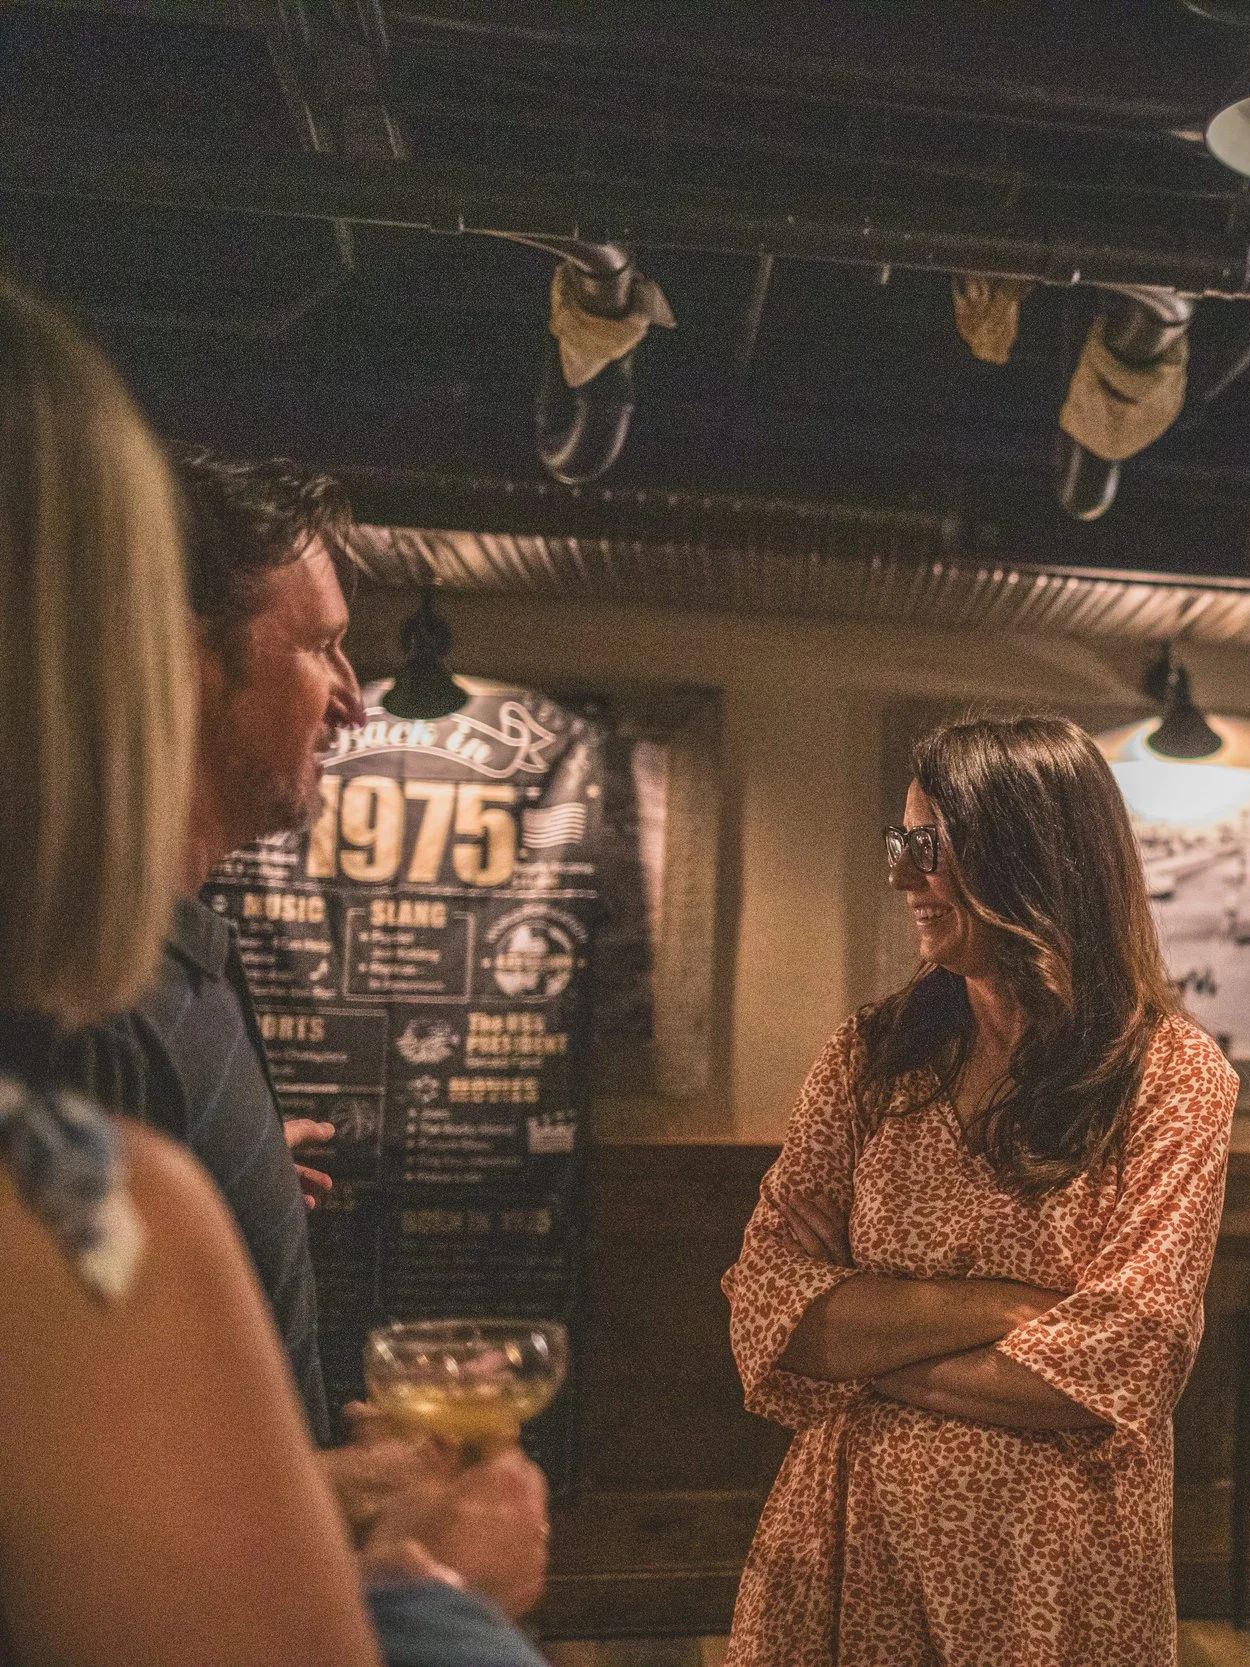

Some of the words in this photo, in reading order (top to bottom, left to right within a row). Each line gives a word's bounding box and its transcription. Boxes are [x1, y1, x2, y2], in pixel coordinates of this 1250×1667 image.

[445, 720, 491, 764] in
[306, 774, 518, 887] 1975
[242, 892, 327, 923] MUSIC
[370, 899, 448, 928] SLANG
[258, 1014, 326, 1042] ORTS
